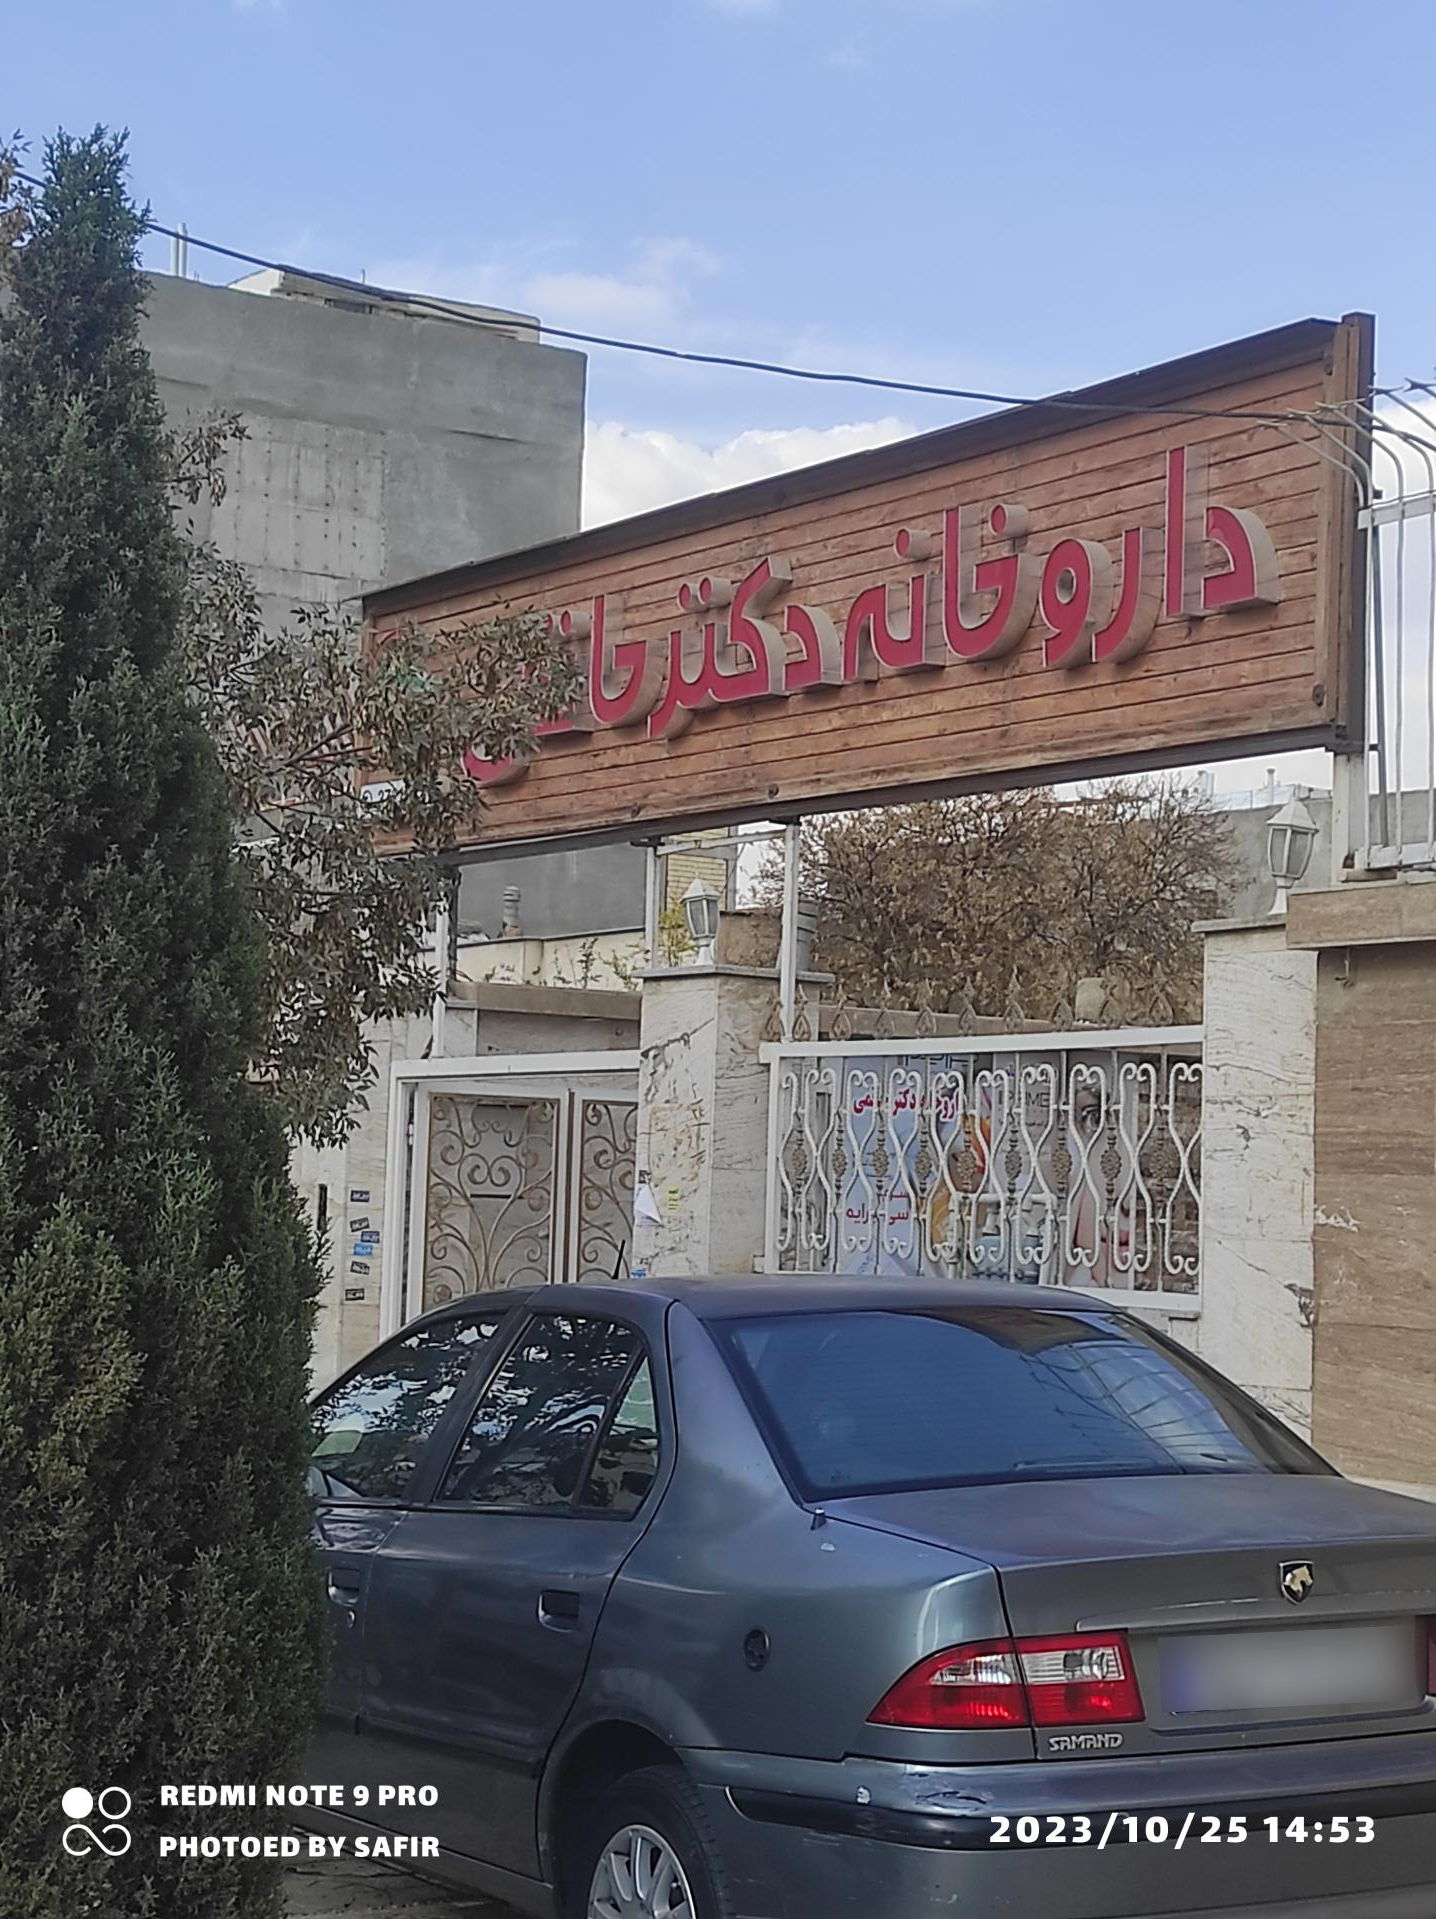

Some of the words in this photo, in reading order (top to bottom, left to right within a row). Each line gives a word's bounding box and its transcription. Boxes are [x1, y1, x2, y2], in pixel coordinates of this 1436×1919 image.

[647, 556, 838, 740] دکتر
[842, 445, 1276, 680] داروخانه
[1048, 1733, 1124, 1752] SAMAND
